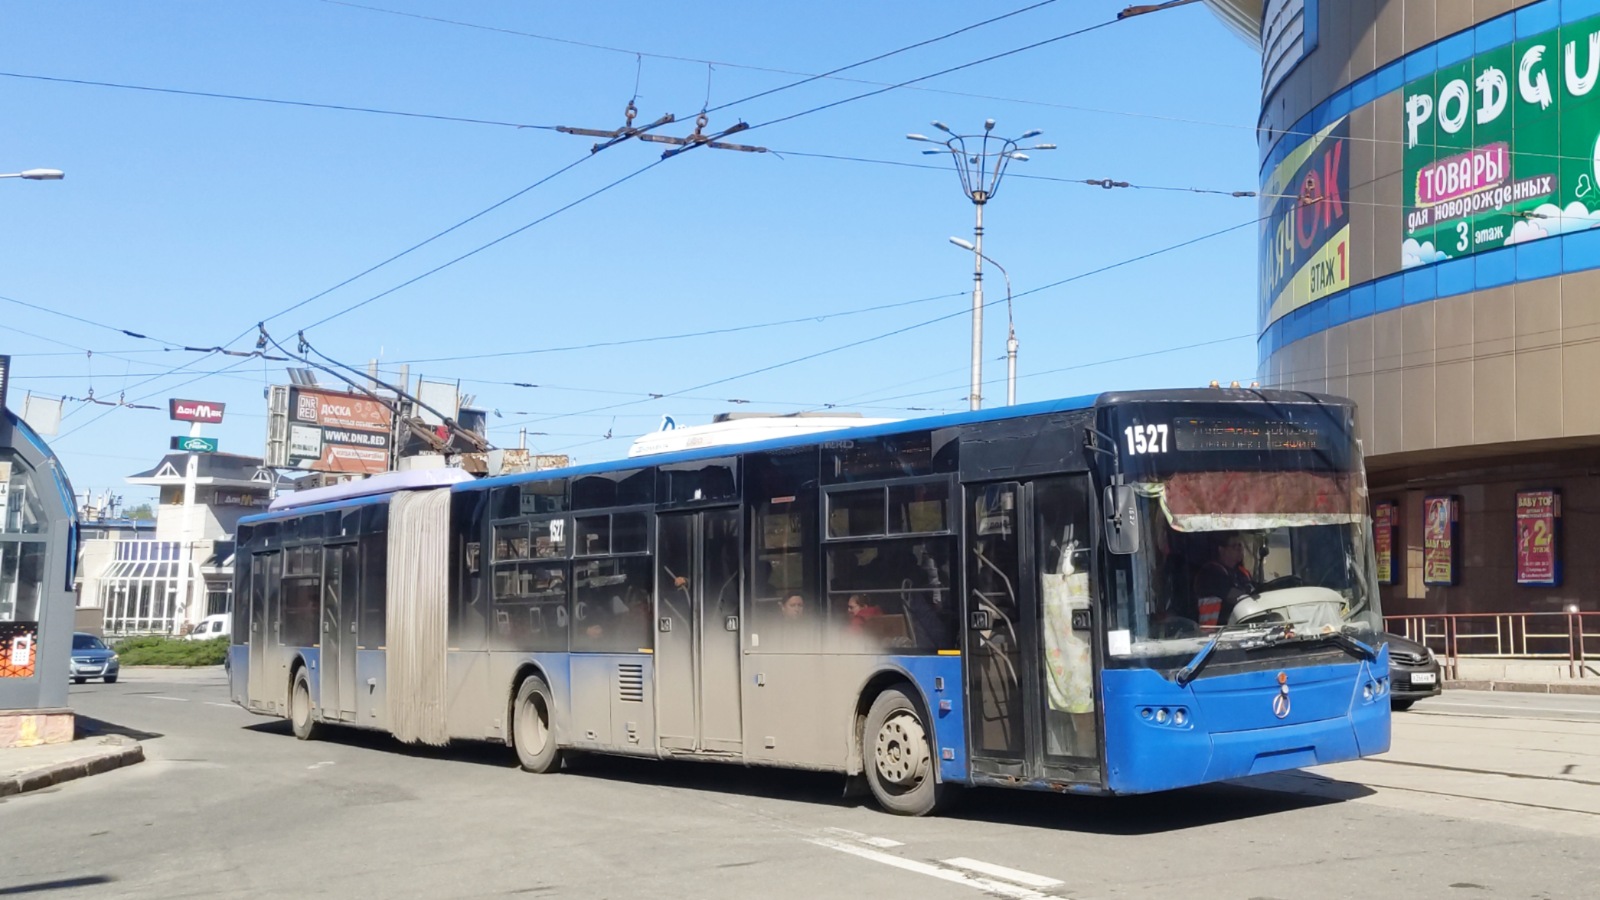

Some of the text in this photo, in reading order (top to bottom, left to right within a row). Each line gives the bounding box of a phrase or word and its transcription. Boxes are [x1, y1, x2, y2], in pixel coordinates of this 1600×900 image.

[1424, 148, 1503, 199] ТОВАРЫ
[1408, 176, 1551, 234] для новорожденных
[1456, 222, 1504, 252] 3 этаж
[1310, 241, 1346, 293] ЭТАЖ 1
[299, 397, 316, 408] DNR
[299, 408, 316, 419] RED
[321, 404, 351, 417] ДОСКА
[325, 430, 386, 446] WWW.DNR.RED
[1124, 424, 1168, 455] 1527
[1518, 496, 1552, 507] BABY TOP
[549, 519, 565, 543] 1527
[1533, 519, 1547, 546] 2
